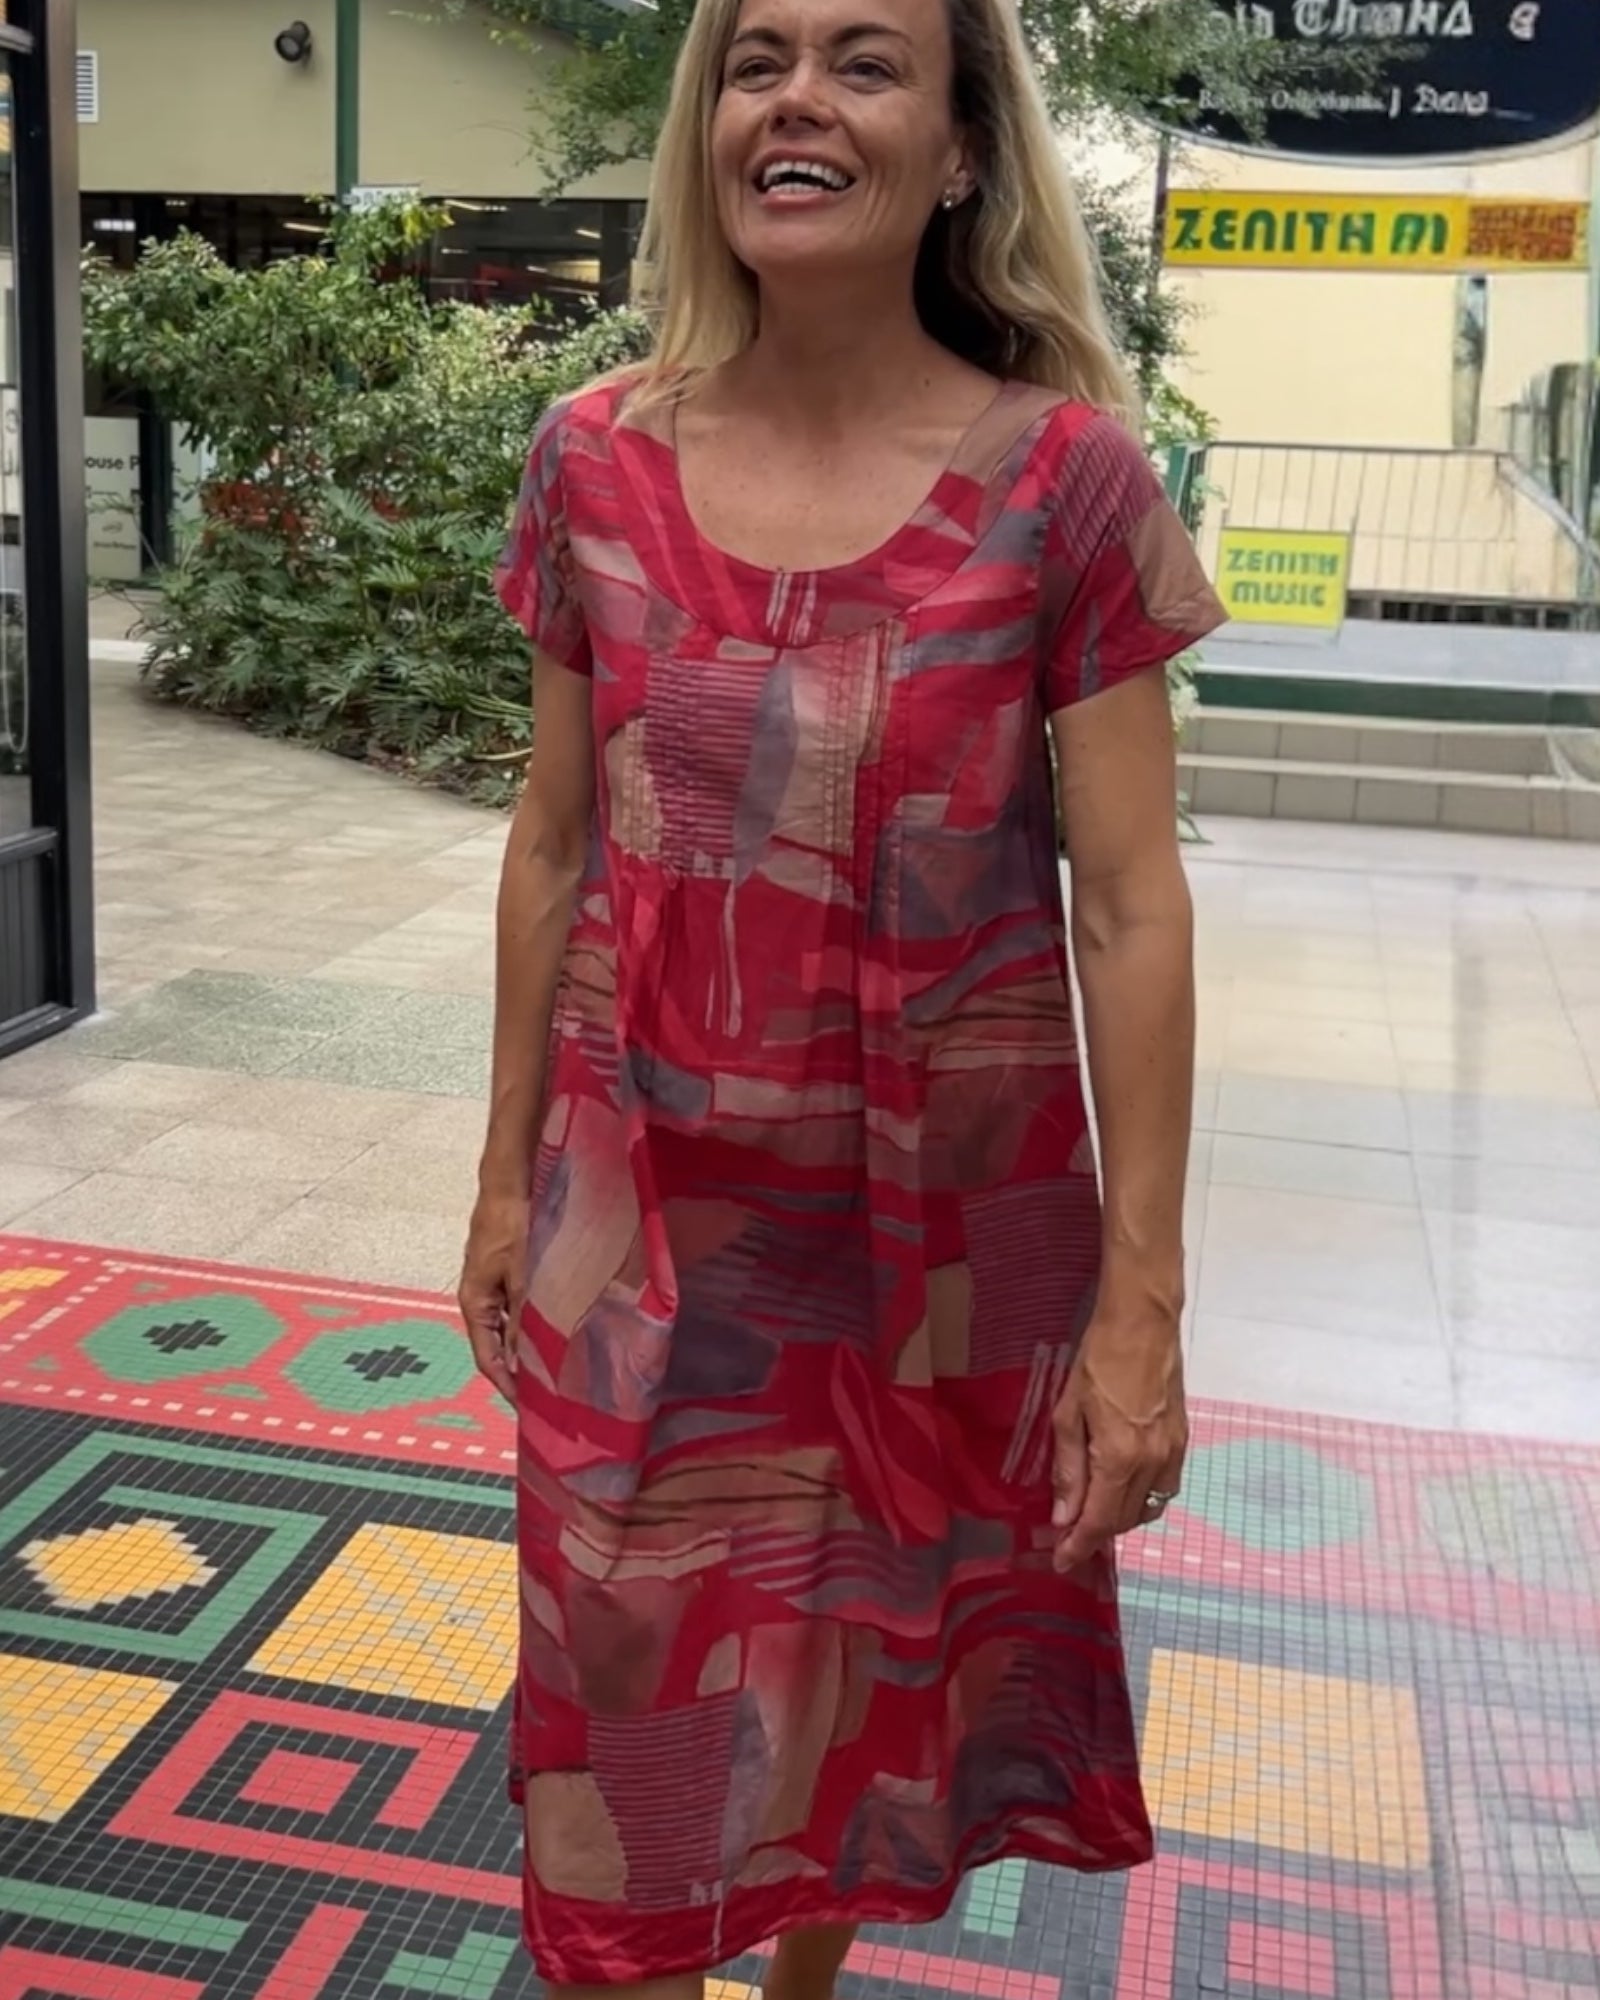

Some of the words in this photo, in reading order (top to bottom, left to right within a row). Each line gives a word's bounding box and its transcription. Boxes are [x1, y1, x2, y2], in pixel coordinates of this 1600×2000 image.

[1172, 208, 1375, 254] ZENITH
[85, 456, 124, 470] ouse
[1227, 549, 1339, 576] ZENITH
[1231, 580, 1327, 607] MUSIC
